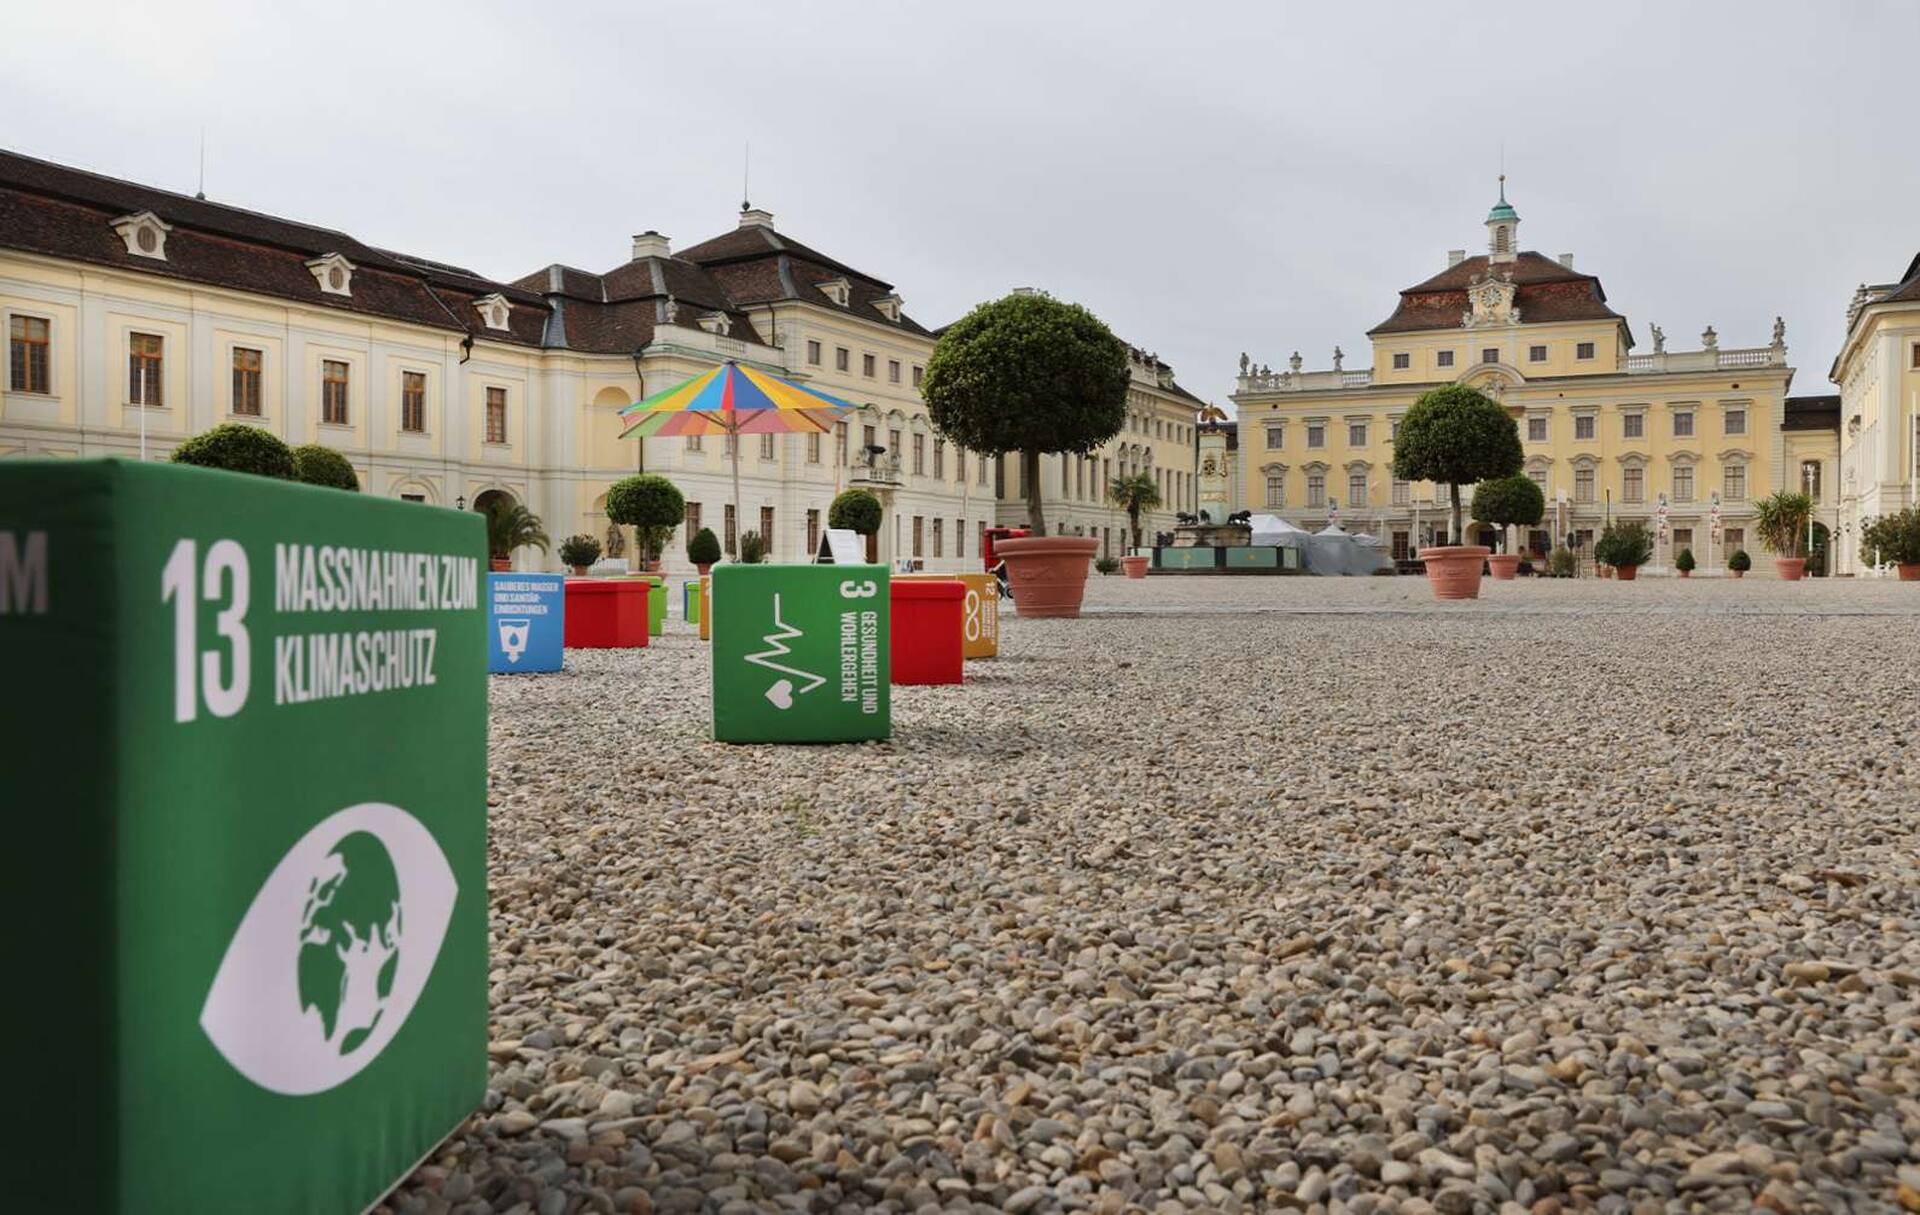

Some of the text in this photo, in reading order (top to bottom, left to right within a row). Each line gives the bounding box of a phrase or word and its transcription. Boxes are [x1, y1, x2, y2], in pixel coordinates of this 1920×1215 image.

[275, 542, 478, 612] MASSNAHMEN ZUM
[840, 580, 877, 599] 3
[161, 537, 251, 723] 13
[275, 628, 437, 705] KLIMASCHUTZ
[840, 612, 858, 702] WOHLERGEHEN
[860, 611, 878, 715] GESUNDHEIT UND
